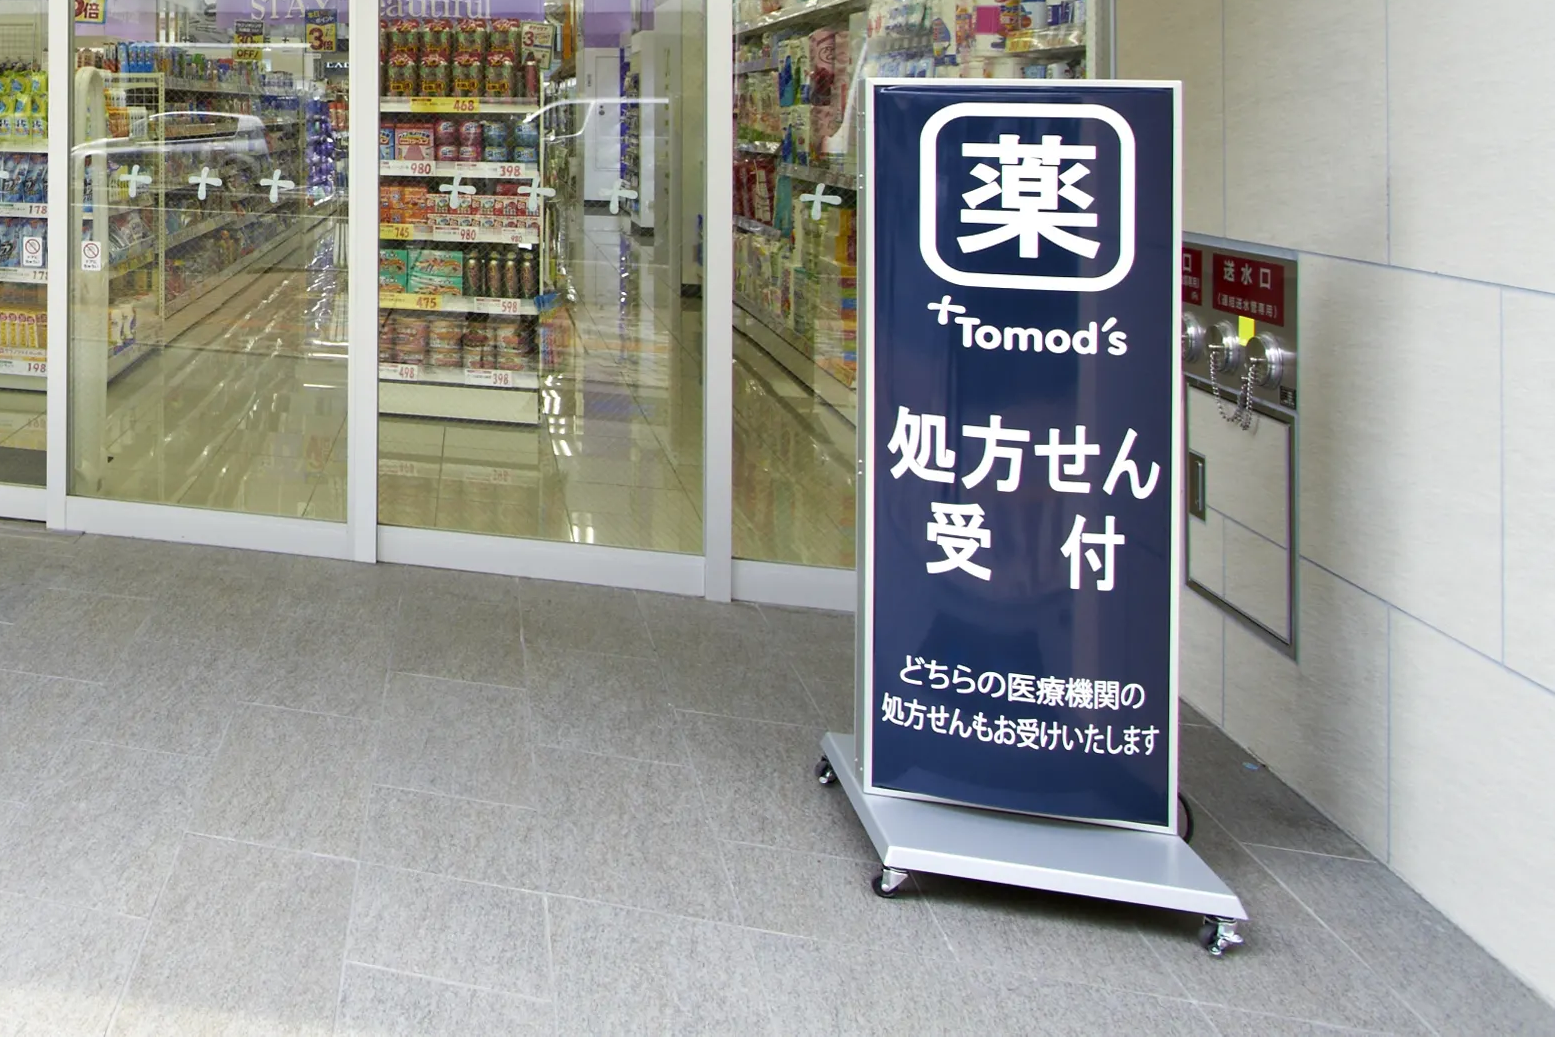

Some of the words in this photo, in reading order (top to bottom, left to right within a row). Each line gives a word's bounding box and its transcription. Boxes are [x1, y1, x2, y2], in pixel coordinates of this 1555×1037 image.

[453, 100, 475, 111] 468
[410, 163, 431, 174] 980
[500, 166, 521, 176] 398
[957, 134, 1100, 259] 薬
[29, 205, 47, 214] 178
[395, 227, 409, 238] 745
[460, 229, 476, 240] 980
[1223, 259, 1271, 290] 送水口
[416, 297, 437, 308] 475
[501, 301, 517, 312] 598
[954, 317, 1127, 355] Tomod's
[28, 363, 47, 372] 198
[399, 367, 415, 379] 498
[493, 374, 509, 385] 398
[887, 406, 1160, 499] 処方せん
[899, 655, 1145, 710] どちらの医療機関の
[881, 692, 1160, 756] 処方せんもお受けいたします
